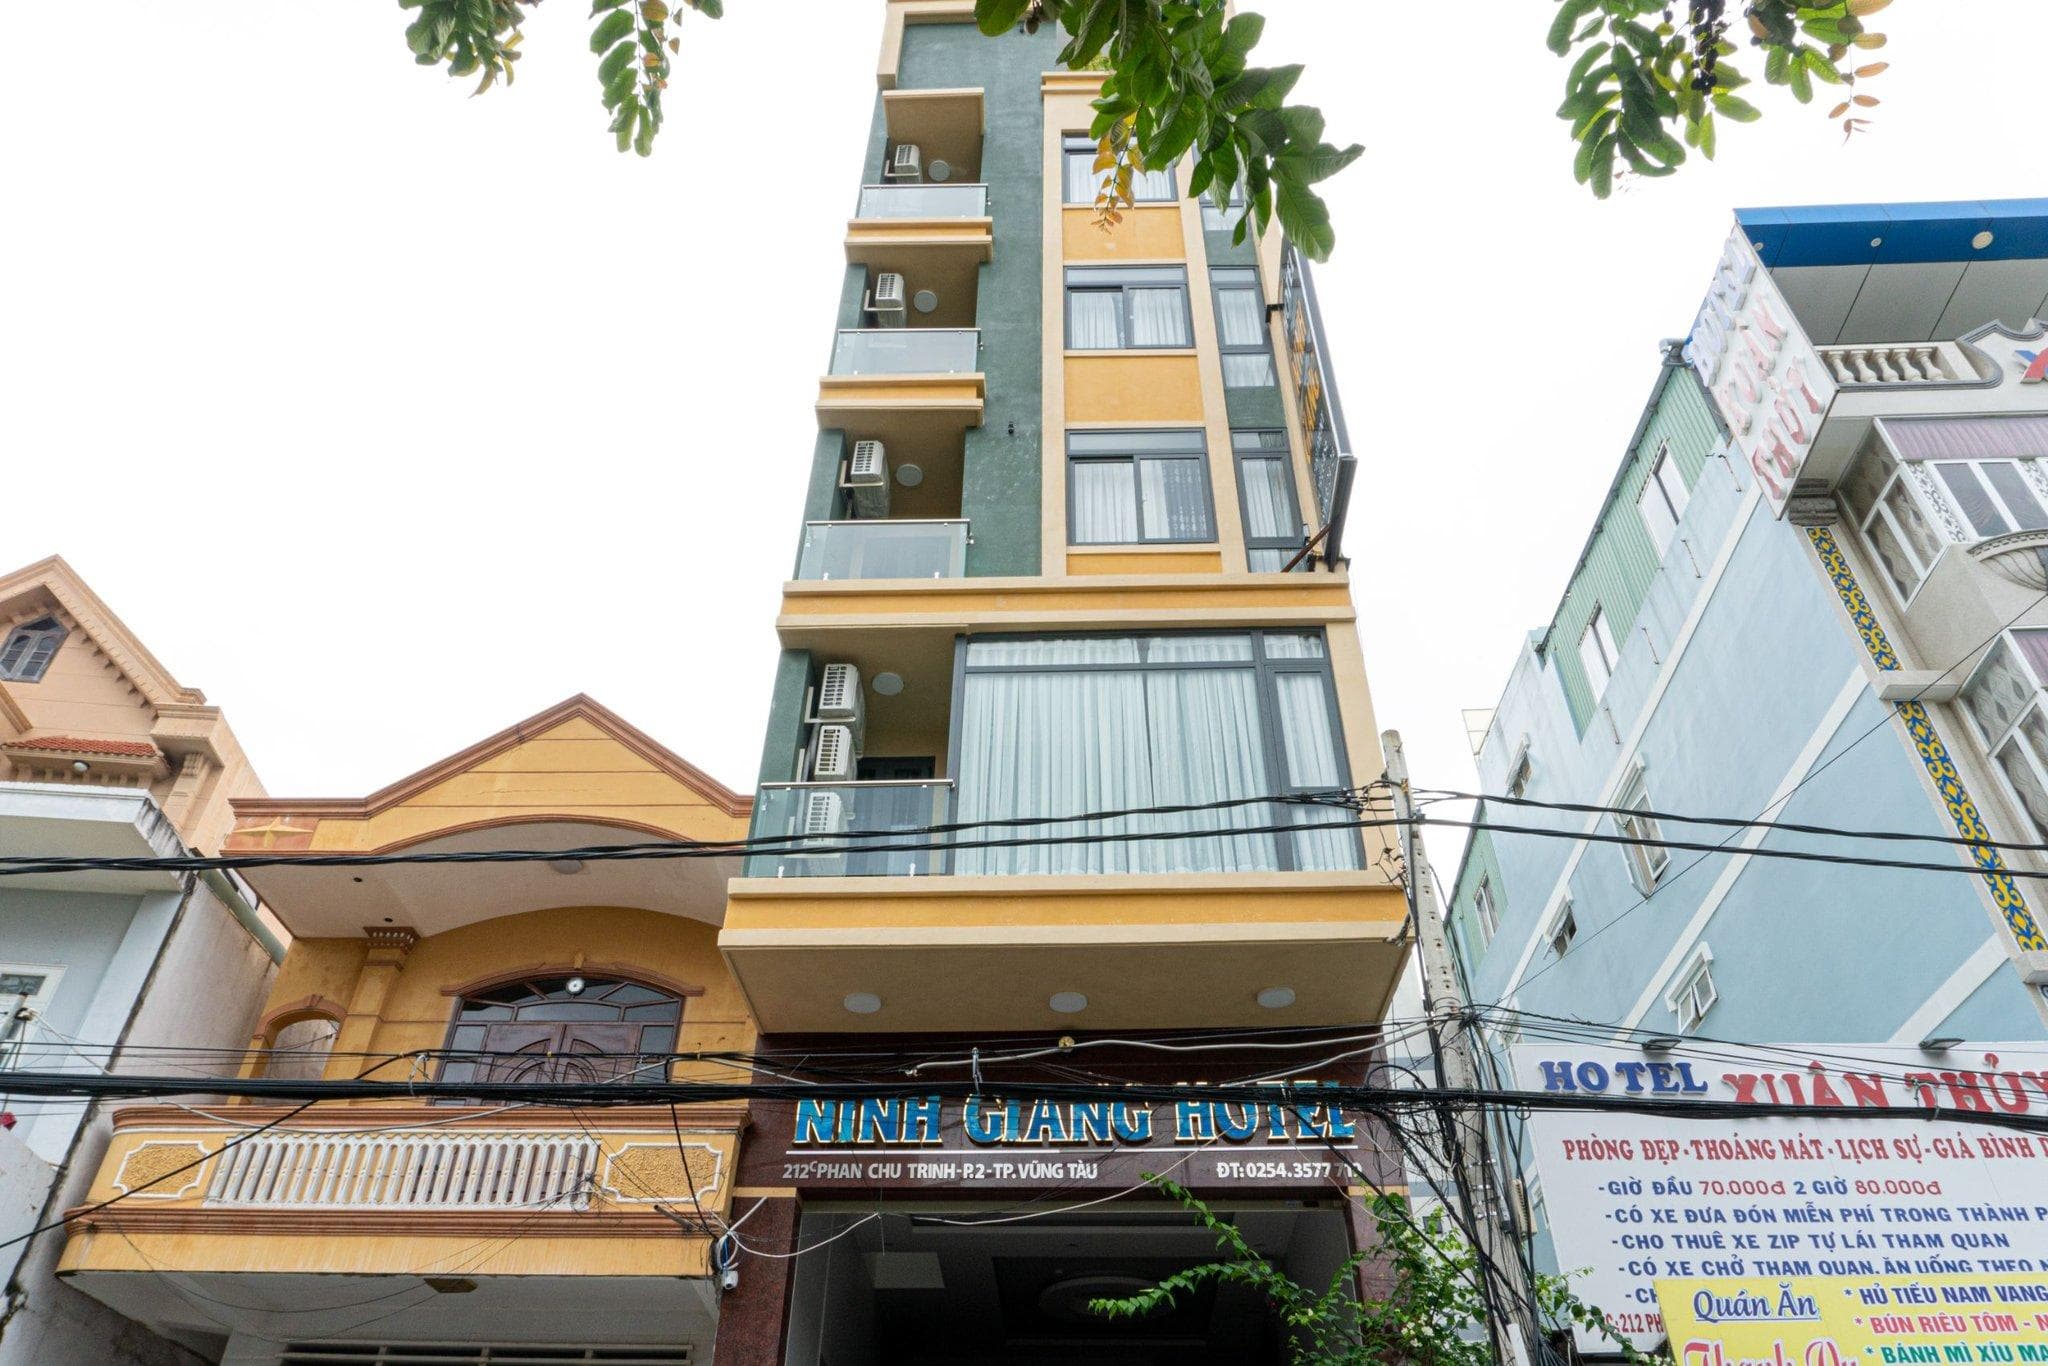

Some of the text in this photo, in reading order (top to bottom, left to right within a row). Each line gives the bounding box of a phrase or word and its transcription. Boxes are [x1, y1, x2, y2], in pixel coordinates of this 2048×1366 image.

[1539, 1060, 1709, 1095] HOTEL
[792, 1080, 1356, 1144] NINH GIANG HOTEL
[1562, 1133, 1634, 1162] PHÒNG
[1977, 1132, 2035, 1159] BÌNH
[868, 1163, 901, 1179] CHU
[1067, 1161, 1098, 1179] TÀU
[1652, 1175, 1693, 1196] ĐẦU
[1699, 1180, 1787, 1196] 70.000đ
[1793, 1180, 1806, 1196] 2
[1812, 1176, 1848, 1196] GIỜ
[1854, 1179, 1942, 1196] 80.000đ
[1650, 1208, 1678, 1224] XE
[1684, 1208, 1727, 1224] ĐƯA
[1733, 1204, 1778, 1224] ĐÓN
[1783, 1201, 1834, 1224] MIỄN
[1839, 1204, 1875, 1223] PHÍ
[1880, 1207, 1951, 1223] TRONG
[1957, 1203, 2030, 1222] THÀNH
[1671, 1231, 1726, 1250] THUÊ
[1731, 1234, 1760, 1250] XE
[1767, 1234, 1801, 1250] ZIP
[1808, 1232, 1836, 1252] TỰ
[1841, 1230, 1876, 1249] LÁI
[1882, 1233, 1945, 1249] THAM
[1951, 1233, 2011, 1251] QUAN
[1665, 1261, 1694, 1276] XE
[1701, 1254, 1745, 1276] CHỞ
[1752, 1260, 1813, 1276] THAM
[1693, 1281, 1817, 1322] Quán Ăn
[1859, 1282, 2048, 1305] HỦ TIẾU NAM VANG
[1870, 1313, 1916, 1334] BÚN
[1918, 1312, 1968, 1333] RIÊU
[1970, 1311, 2018, 1332] TÔM
[1881, 1342, 1942, 1364] BÁNH
[1944, 1341, 1973, 1363] MÌ
